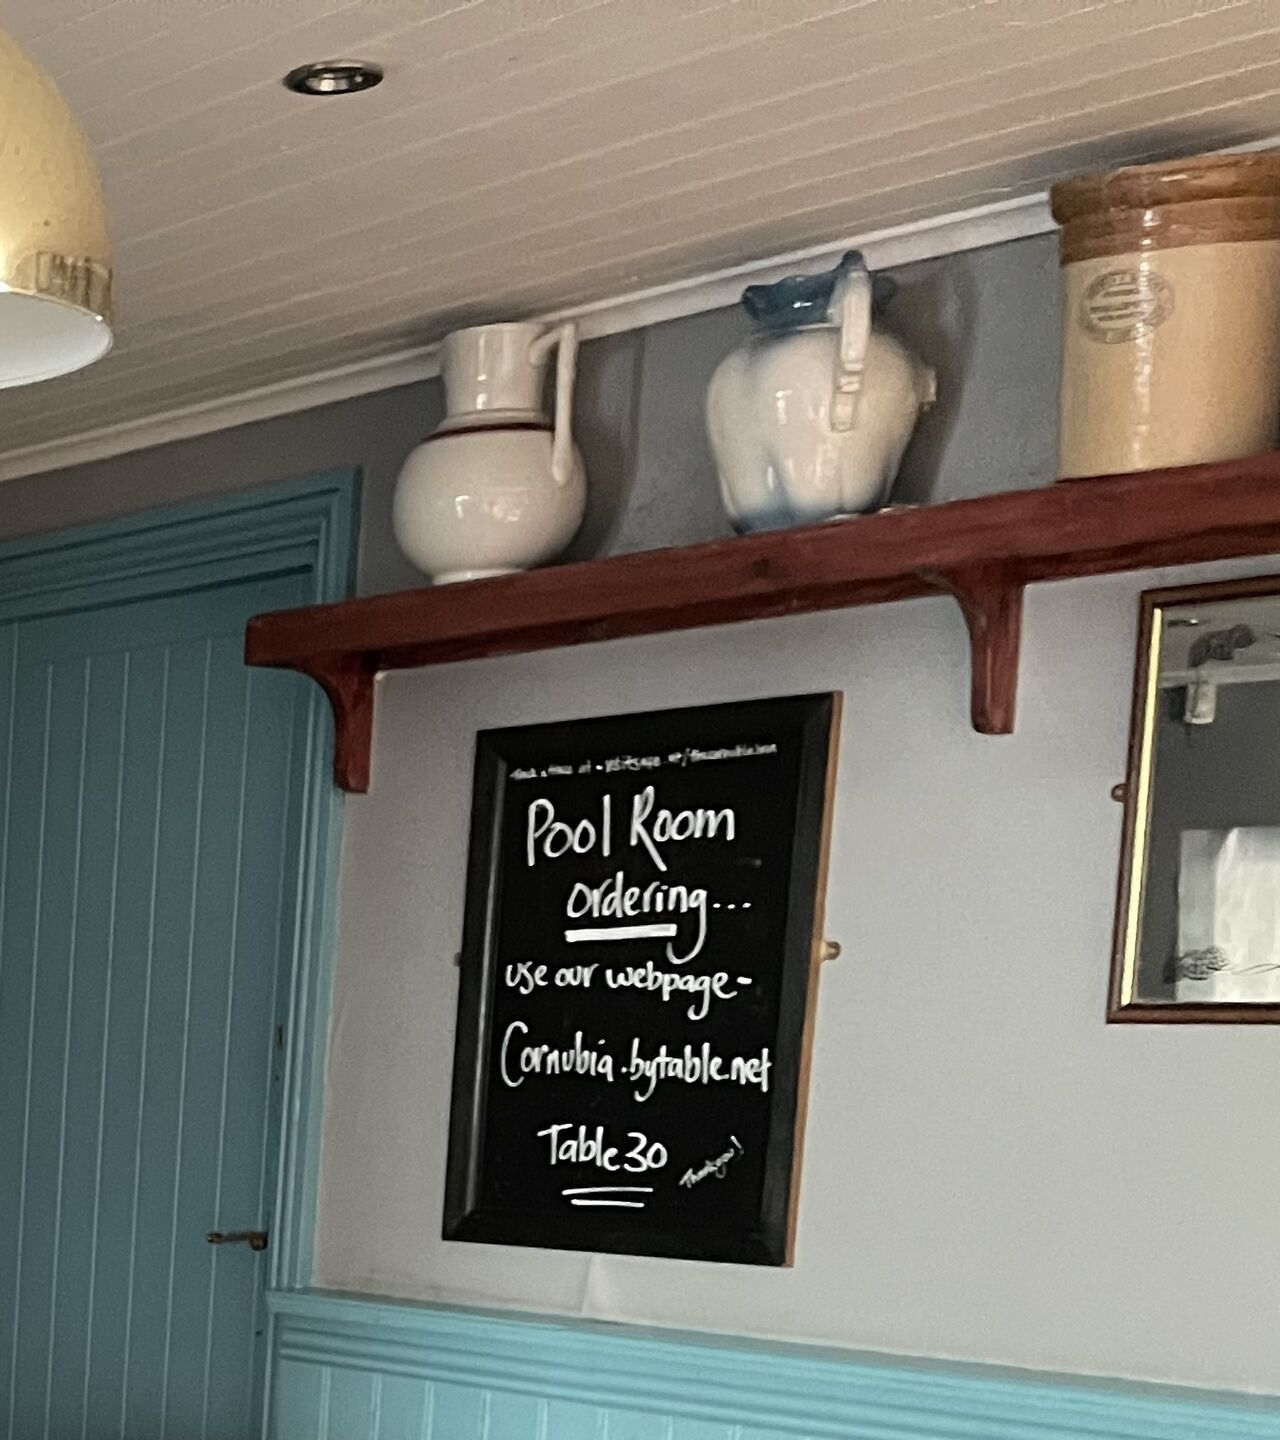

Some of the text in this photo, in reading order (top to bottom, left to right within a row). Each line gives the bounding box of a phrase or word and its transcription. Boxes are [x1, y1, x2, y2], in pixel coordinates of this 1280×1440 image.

[526, 785, 735, 872] Pool Room
[554, 963, 600, 988] our
[536, 1122, 668, 1173] Table 30
